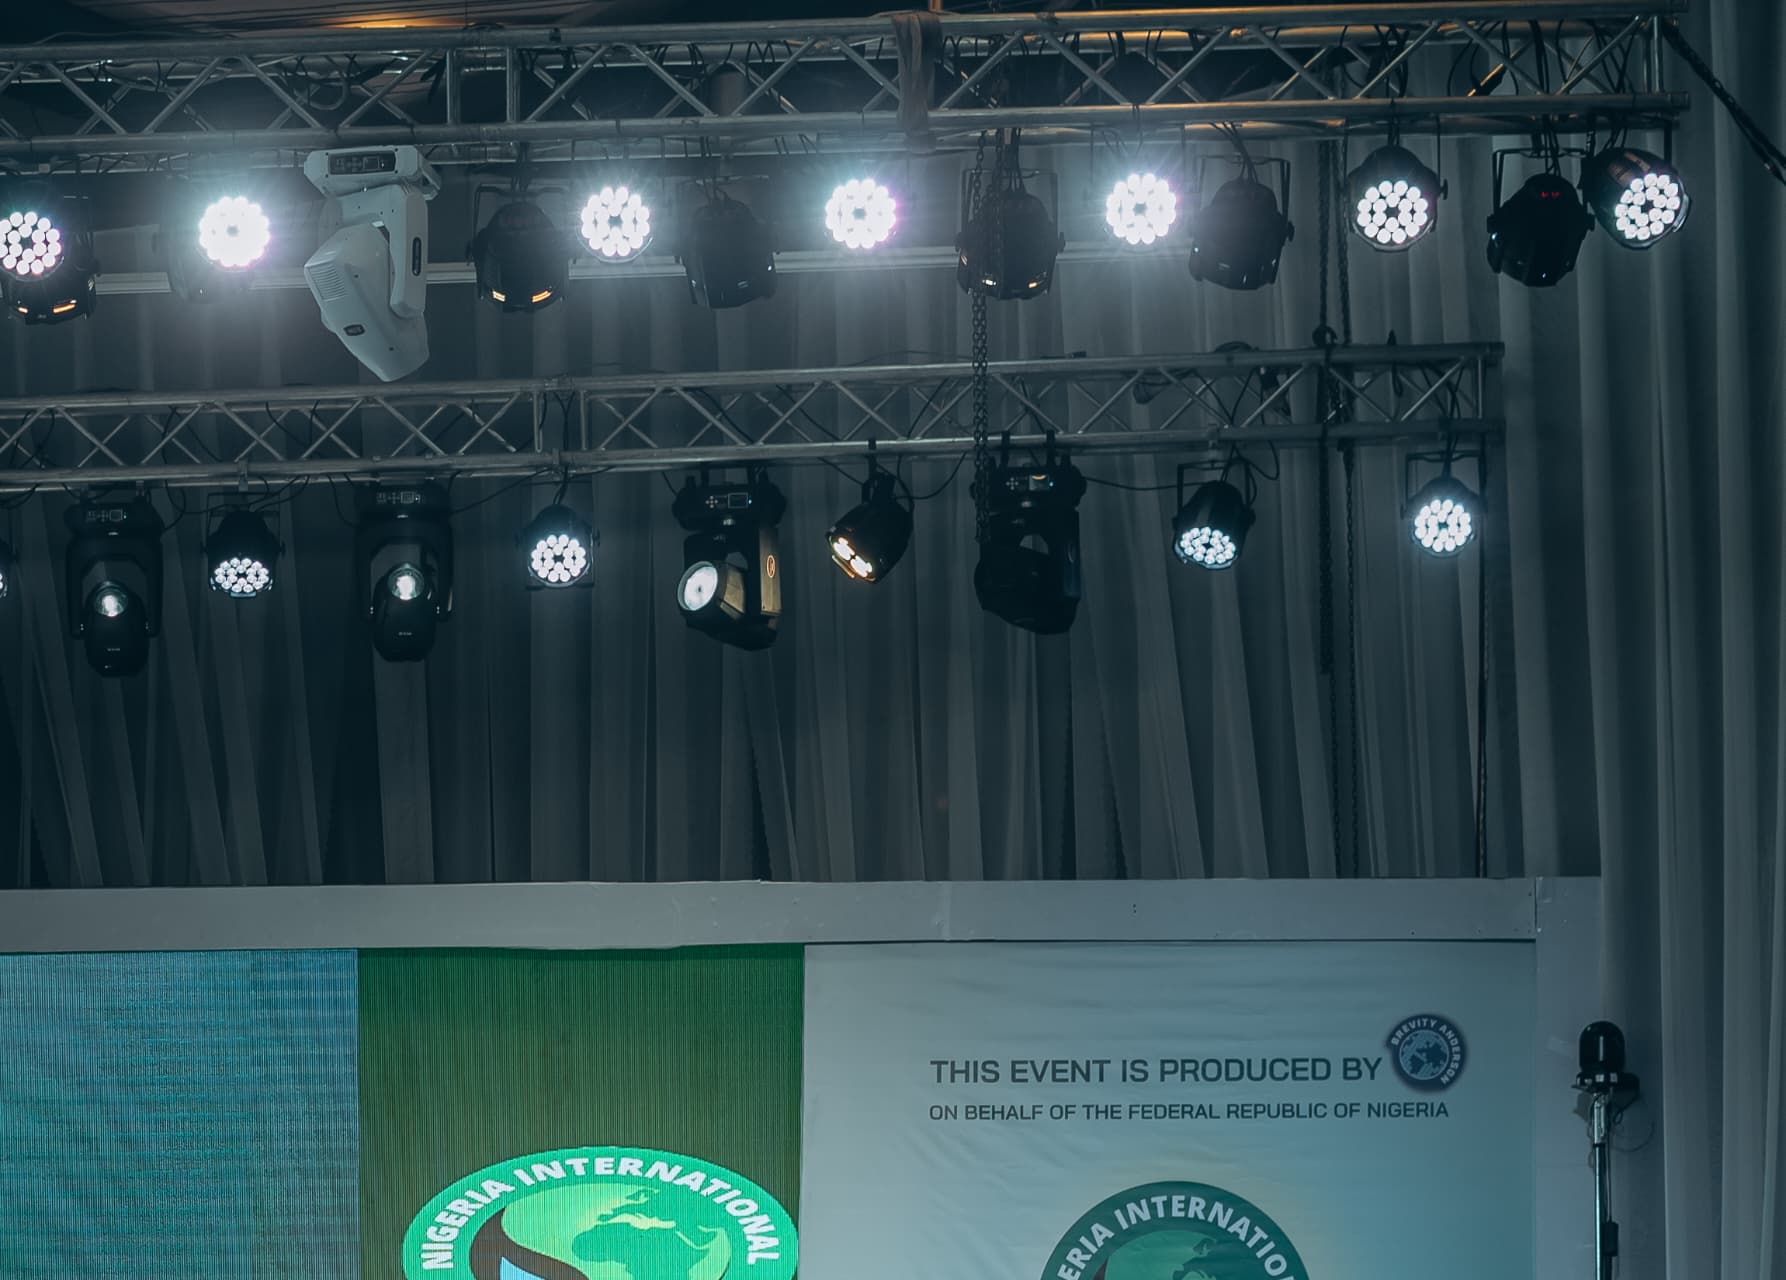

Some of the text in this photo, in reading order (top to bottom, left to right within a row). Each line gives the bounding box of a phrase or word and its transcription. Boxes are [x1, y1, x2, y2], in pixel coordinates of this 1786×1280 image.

[930, 1057, 1383, 1084] THIS EVENT IS PRODUCED BY
[1391, 1018, 1461, 1084] BREVITY ANDERSON
[929, 1102, 1449, 1121] ON BEHALF OF THE FEDERAL REPUBLIC OF NIGERIA
[421, 1157, 781, 1270] NIGERIA INTERNATIONAL
